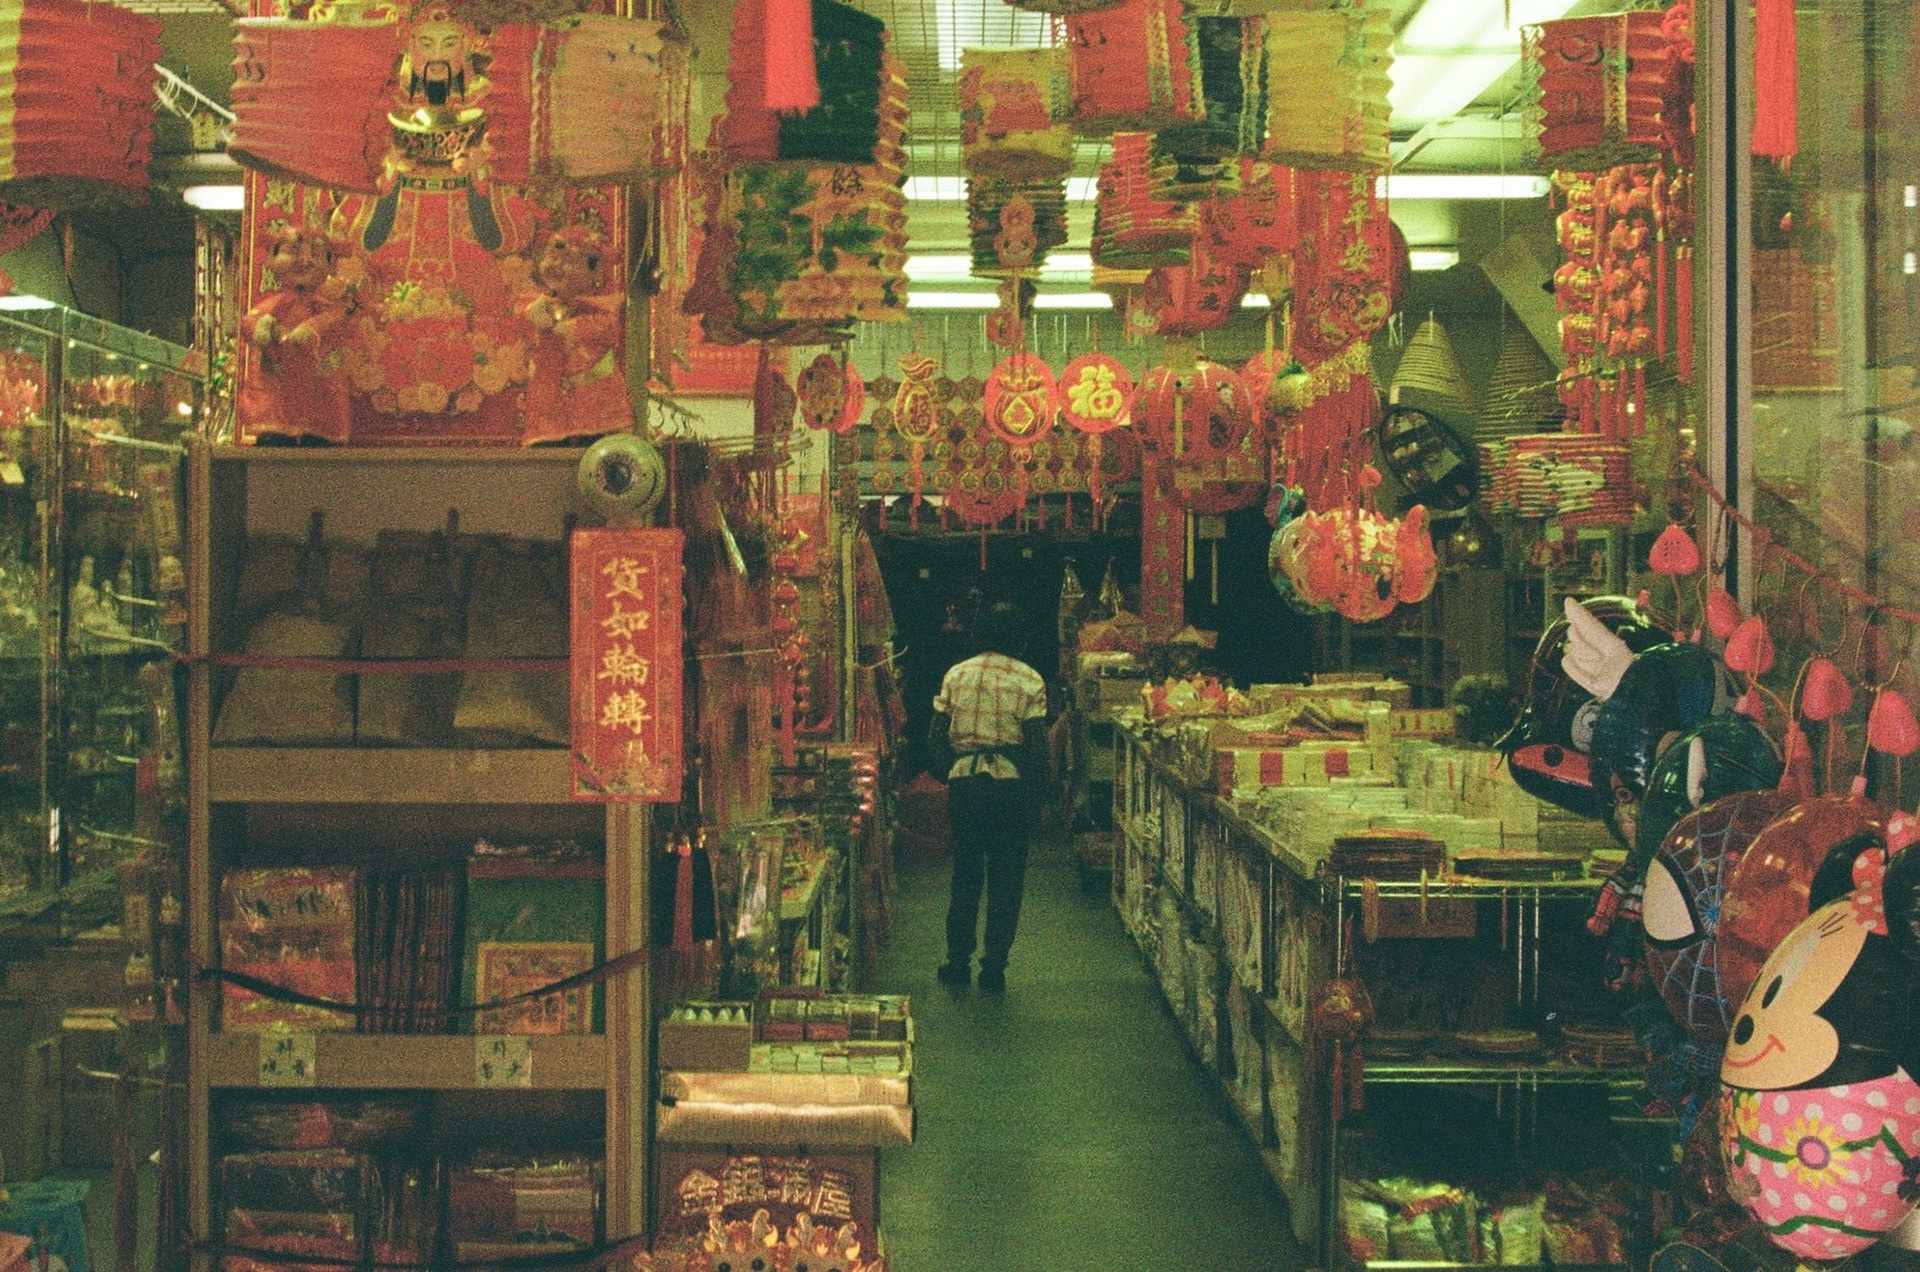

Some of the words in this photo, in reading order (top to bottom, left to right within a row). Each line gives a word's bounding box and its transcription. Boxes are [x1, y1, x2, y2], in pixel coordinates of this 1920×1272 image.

[1068, 363, 1122, 418] 福
[599, 556, 651, 733] 貨如輪轉
